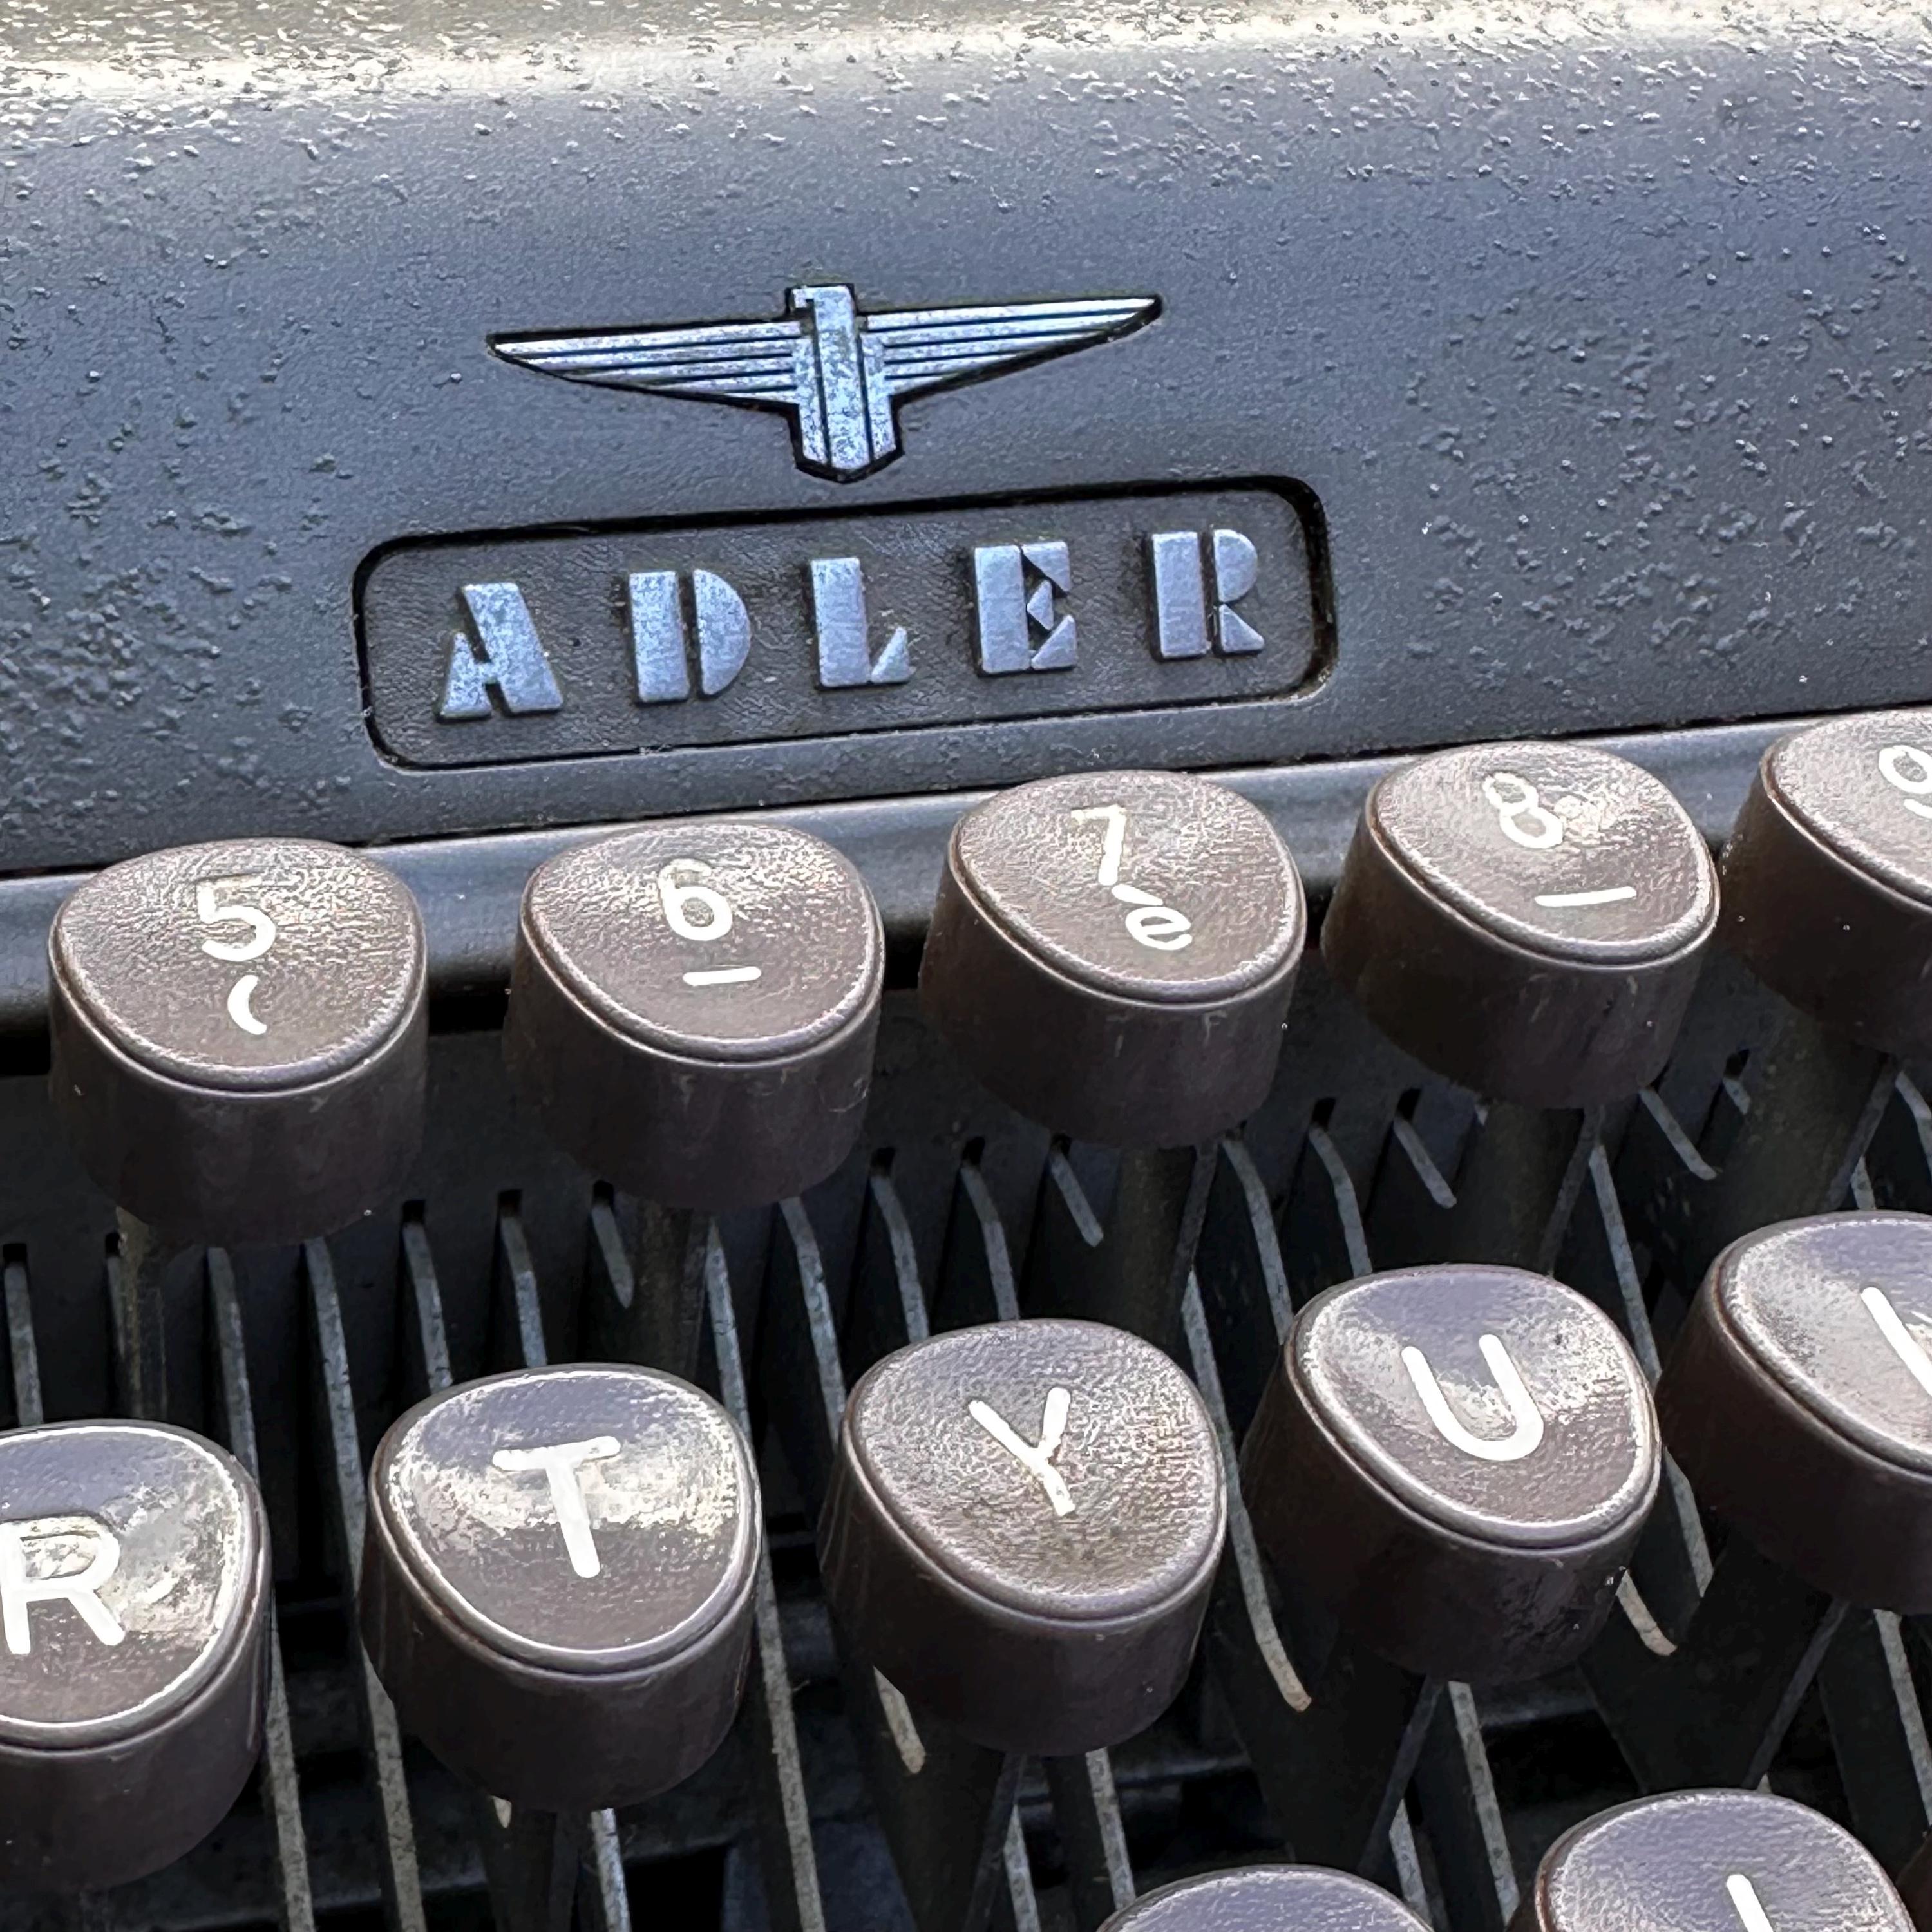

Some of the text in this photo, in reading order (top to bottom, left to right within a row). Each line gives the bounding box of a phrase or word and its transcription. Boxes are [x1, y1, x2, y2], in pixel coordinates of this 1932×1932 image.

[438, 527, 1266, 720] ADLER
[1071, 804, 1127, 886] 7
[1482, 773, 1564, 849] 8
[196, 875, 276, 961] 5
[658, 858, 732, 940] 6
[227, 975, 267, 1034] (
[1401, 1334, 1544, 1461] U
[969, 1387, 1077, 1516] Y
[493, 1435, 621, 1578] T
[0, 1515, 125, 1654] R
